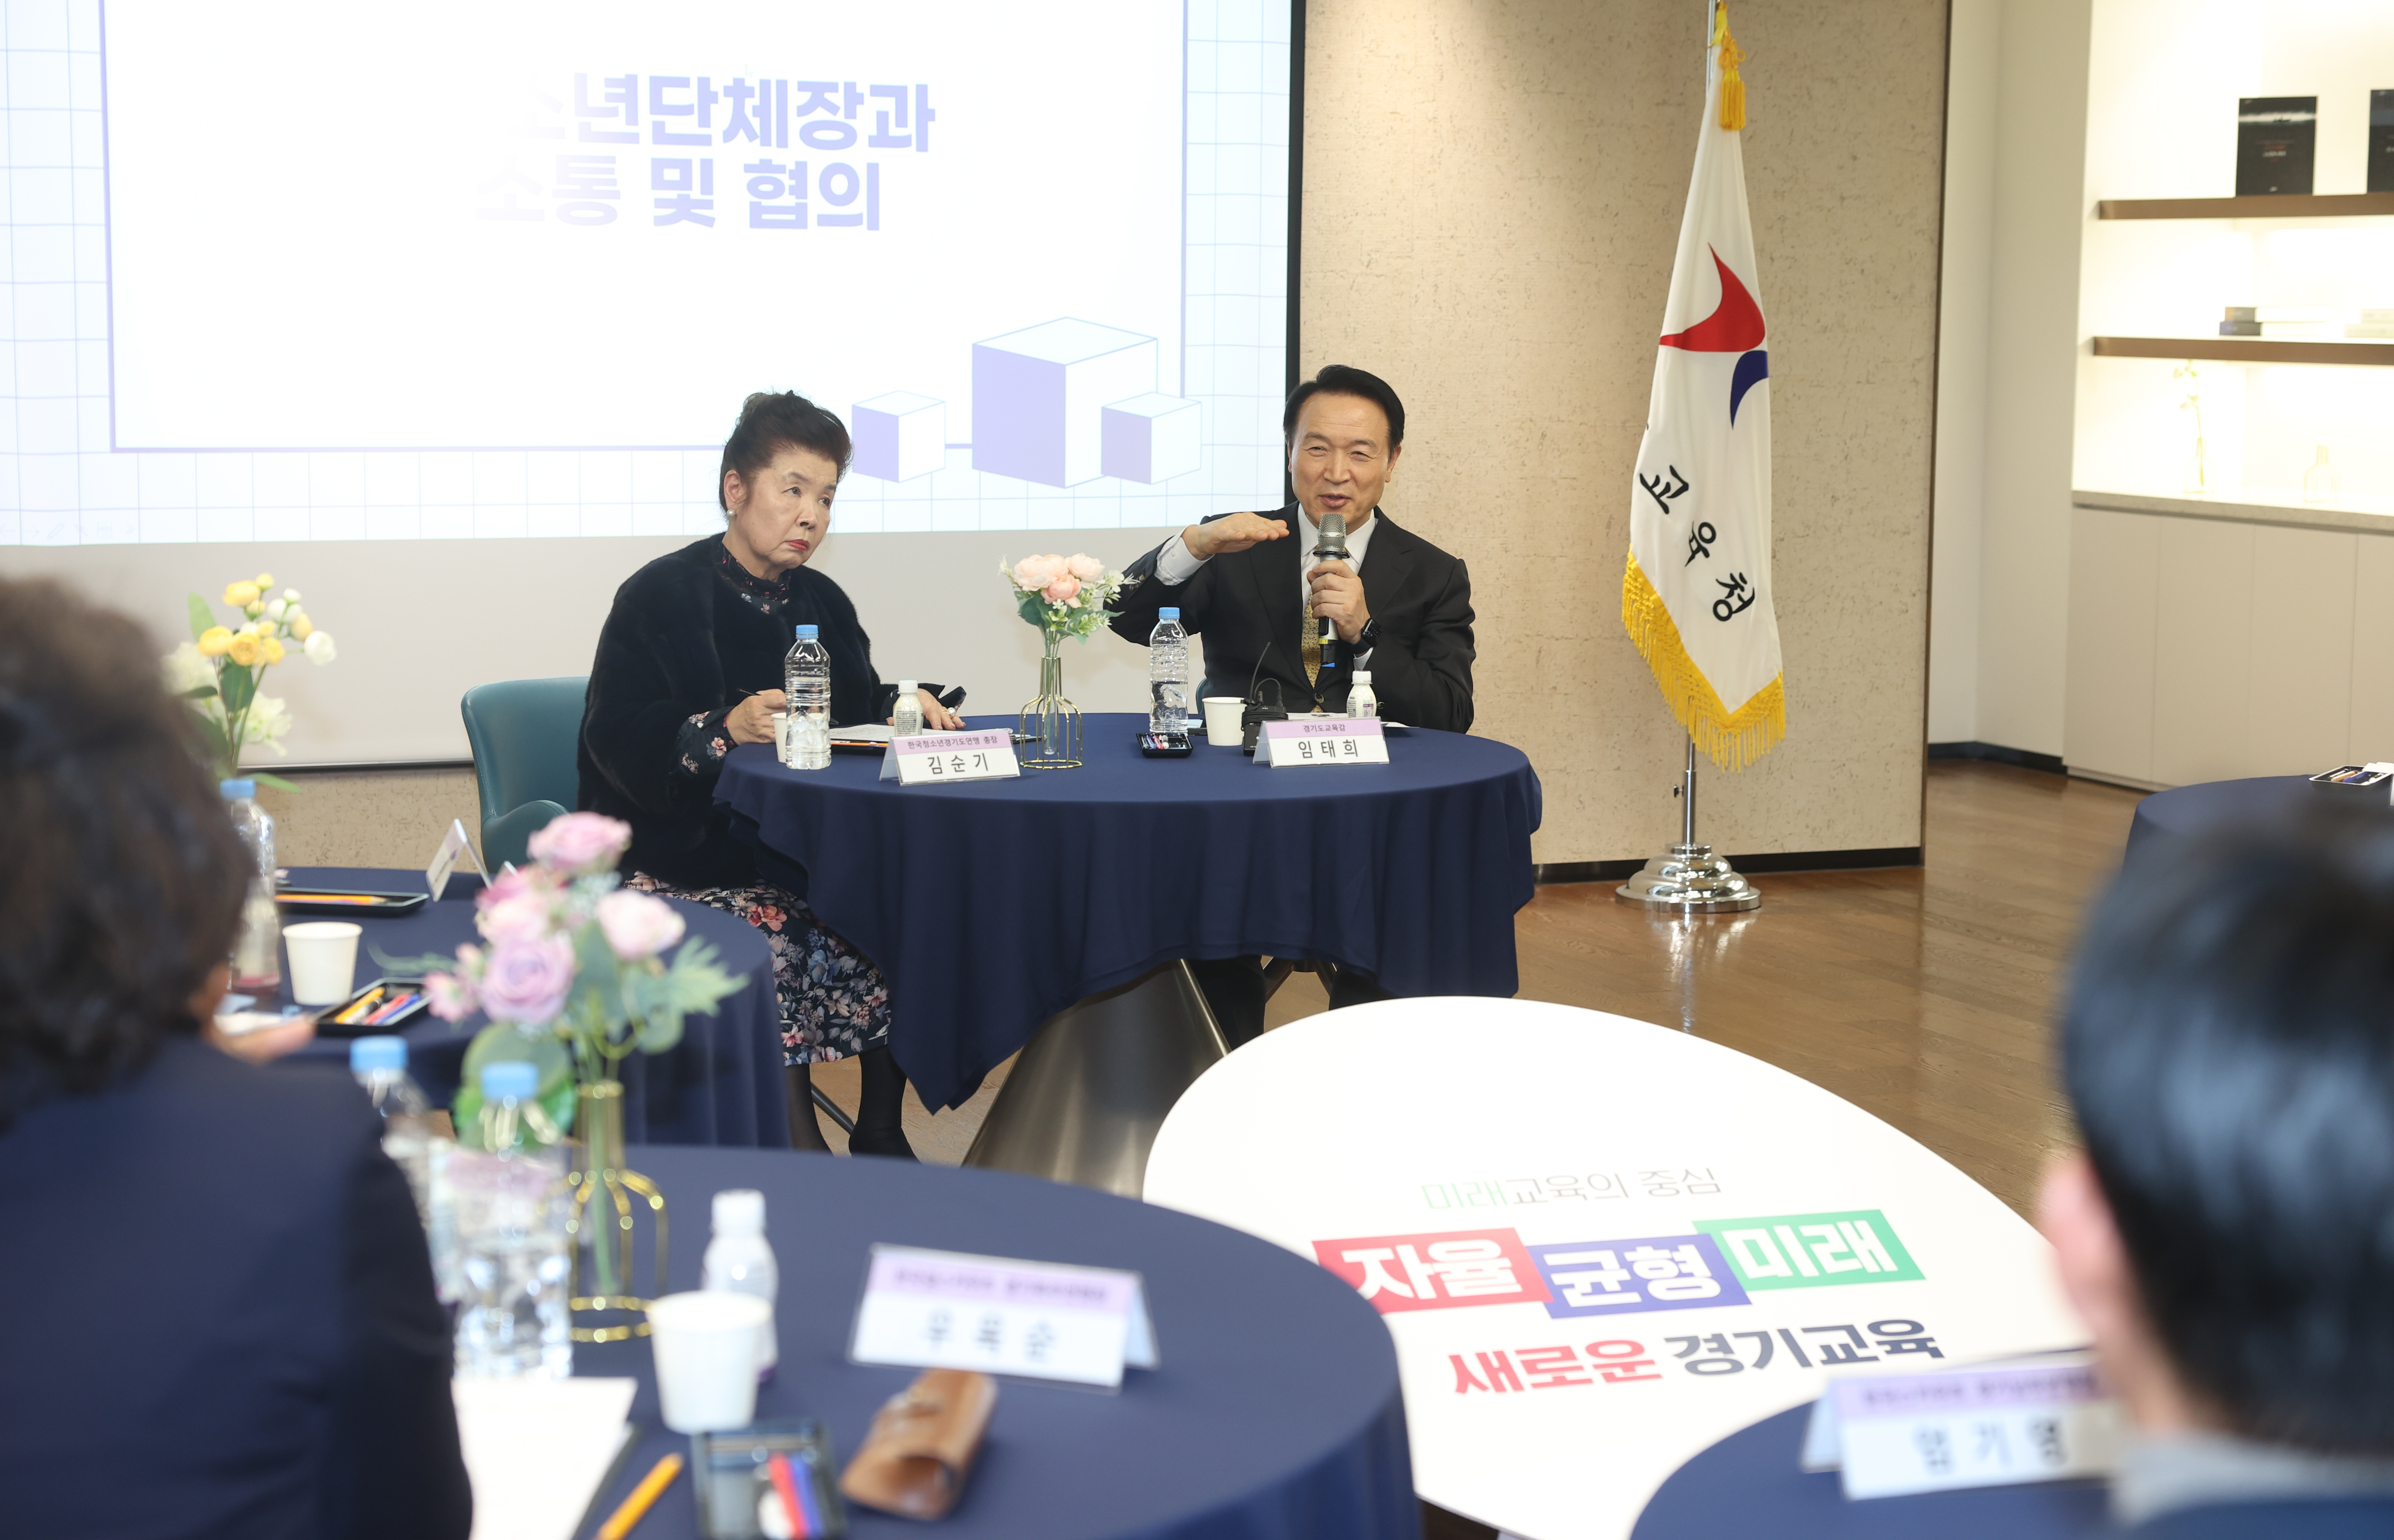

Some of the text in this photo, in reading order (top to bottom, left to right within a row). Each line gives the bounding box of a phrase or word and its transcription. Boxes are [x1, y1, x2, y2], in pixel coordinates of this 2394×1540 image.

[475, 155, 880, 231] 소통 및 협의
[908, 736, 997, 749] 한국청소년경기도연맹 총장
[1303, 724, 1345, 732] 경기도교육감
[1421, 1168, 1722, 1209] 미래교육의 중심
[1341, 1219, 1900, 1309] 자율 균형 미래
[1448, 1318, 1945, 1396] 새로운 경기교육
